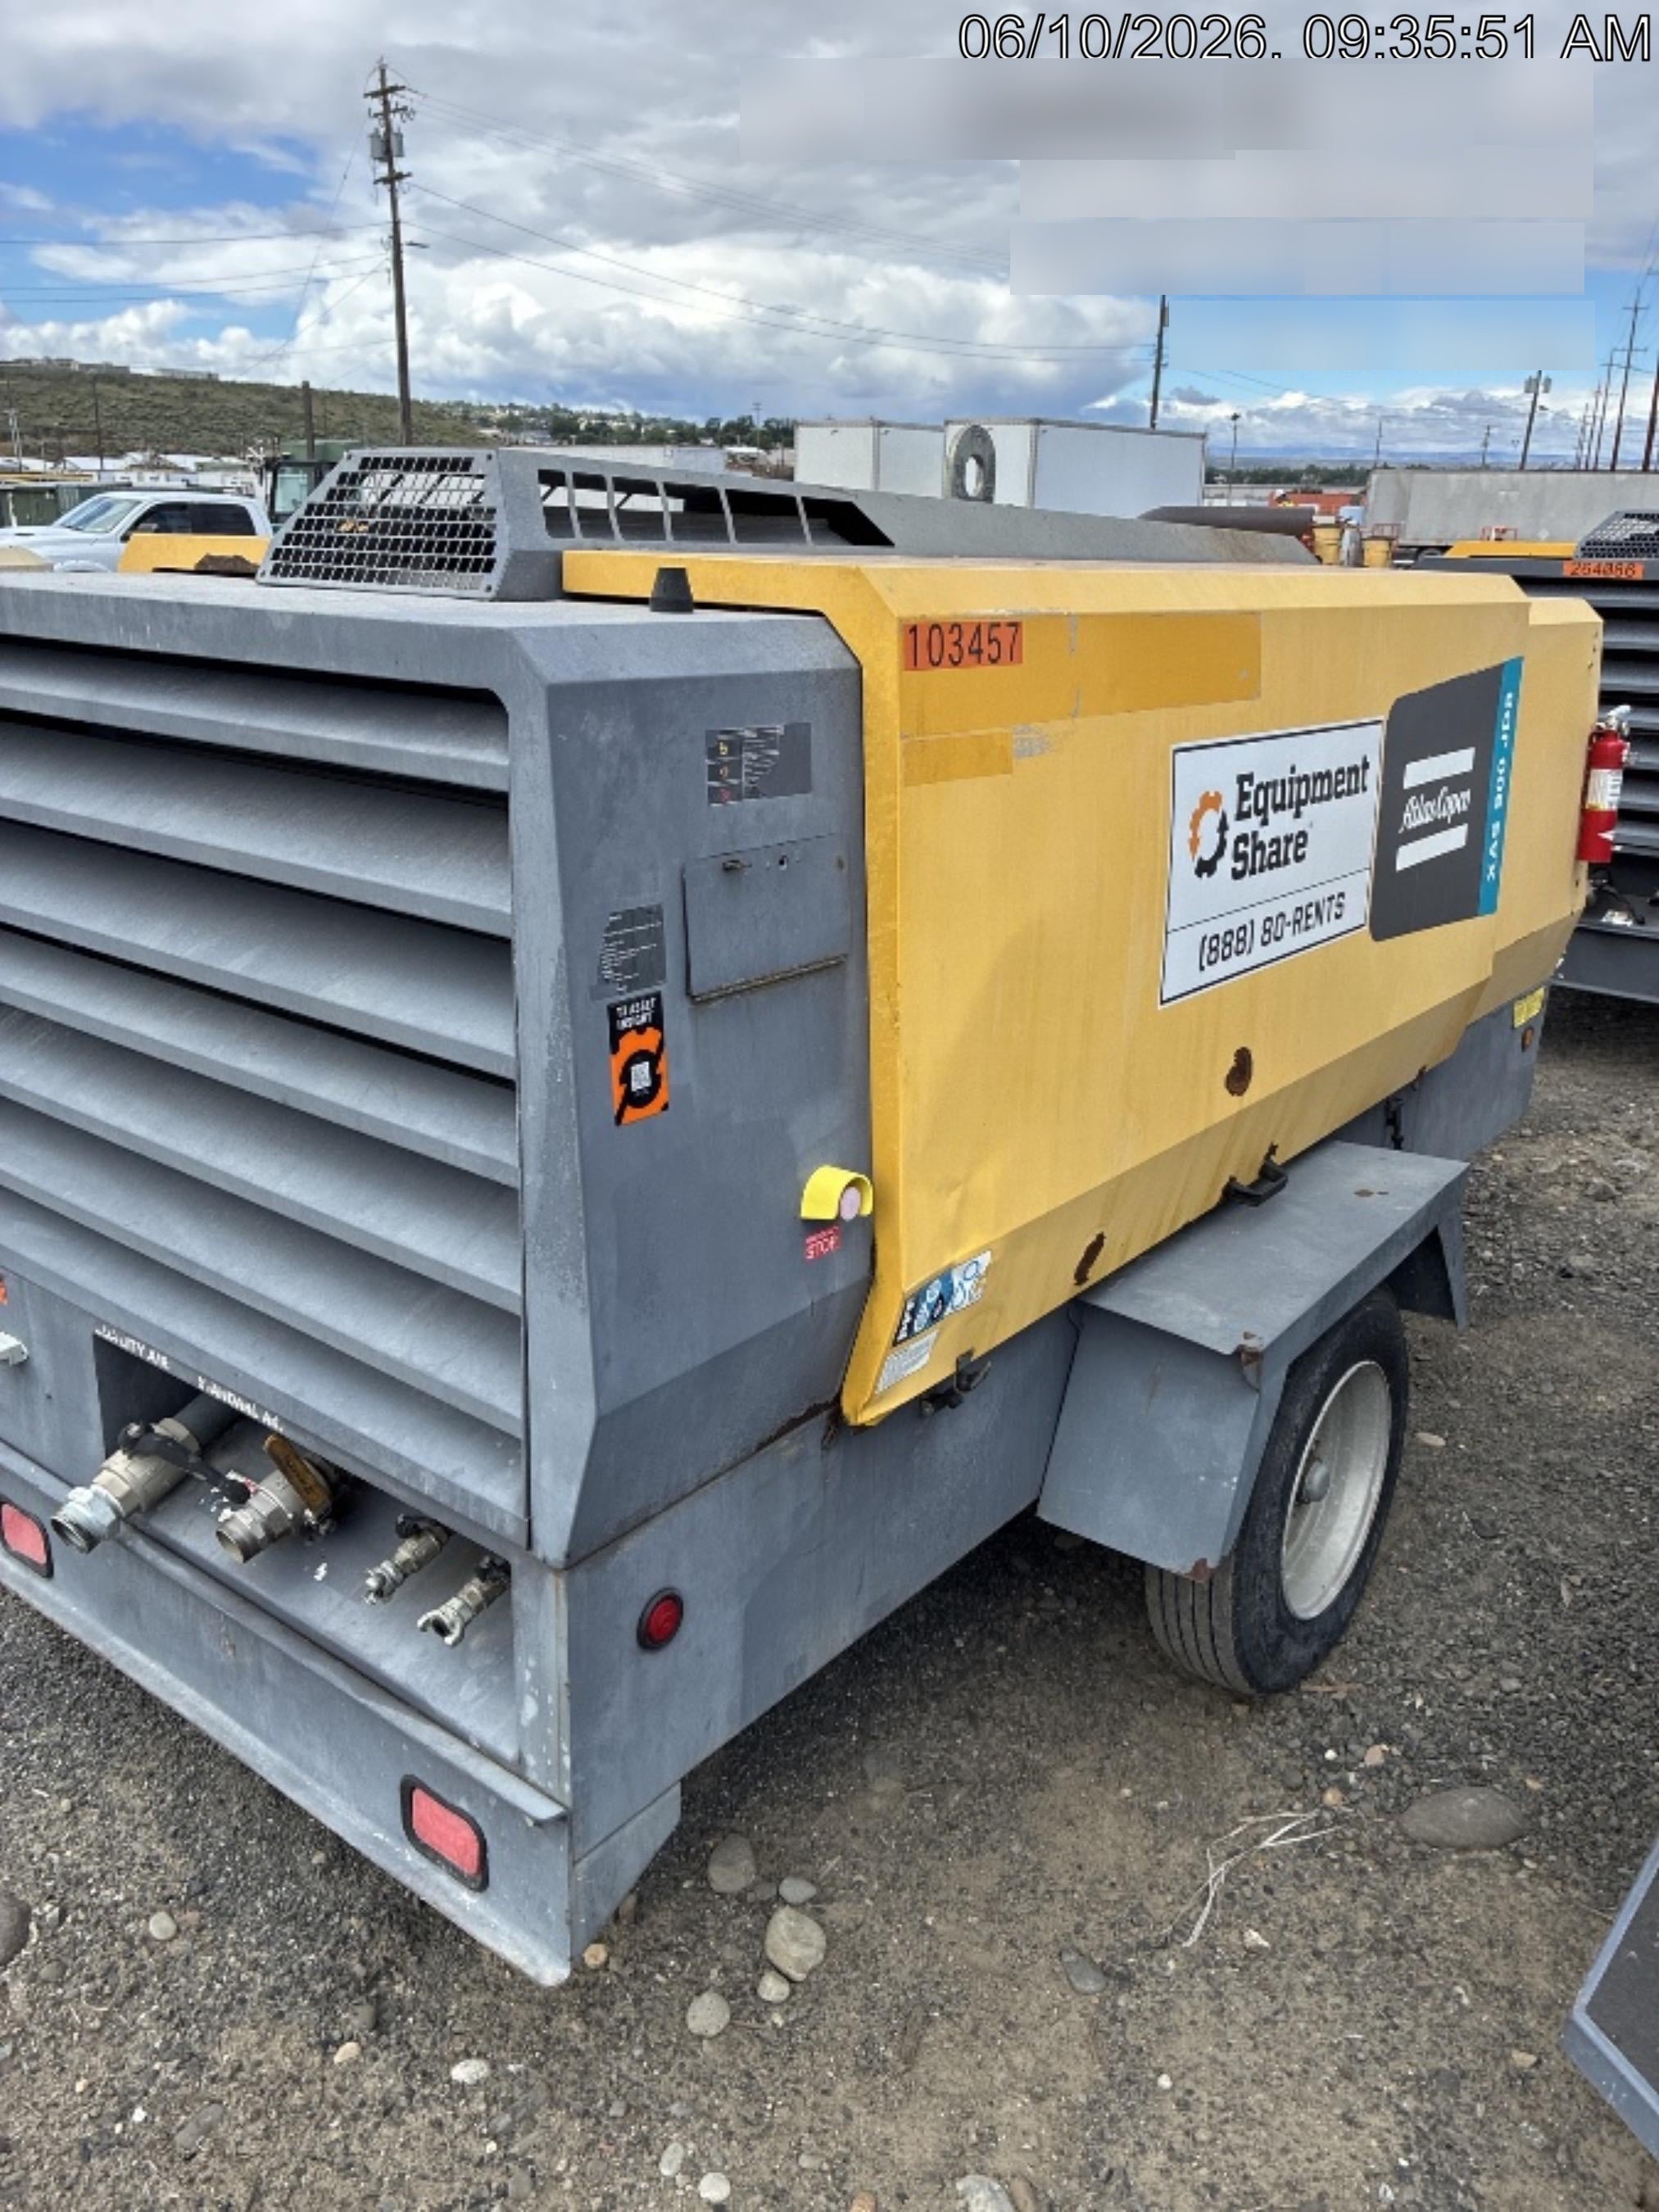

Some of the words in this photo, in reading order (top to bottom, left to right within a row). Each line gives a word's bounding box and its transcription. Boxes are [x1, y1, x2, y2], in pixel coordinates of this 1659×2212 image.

[909, 622, 1019, 668] 103457
[1235, 754, 1370, 827] Equipment
[1231, 830, 1308, 881] Share
[1199, 918, 1255, 972] (888)
[1261, 891, 1345, 947] 80-RENTS
